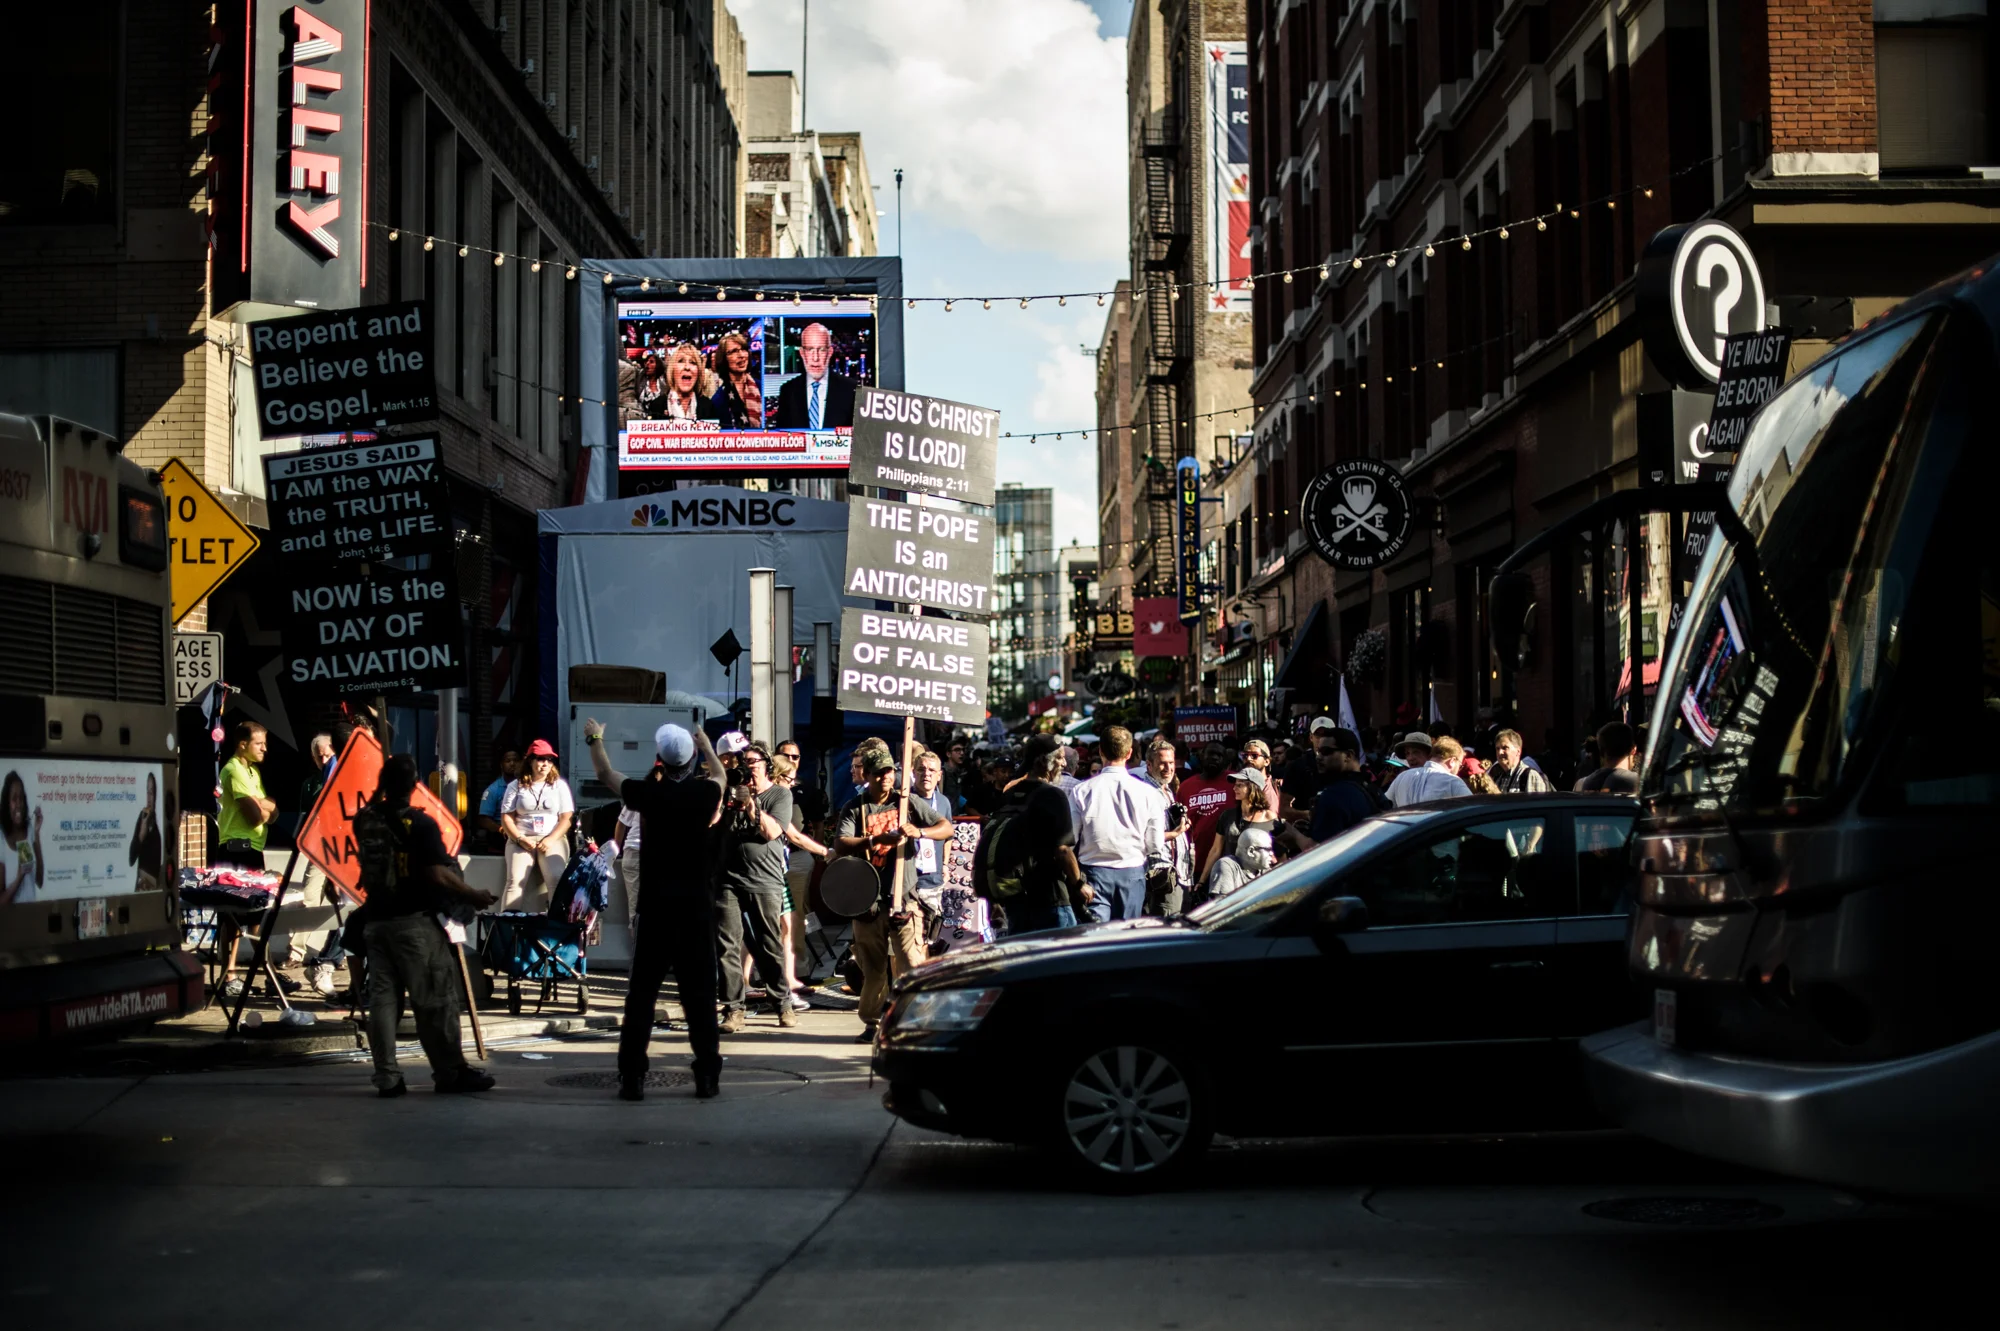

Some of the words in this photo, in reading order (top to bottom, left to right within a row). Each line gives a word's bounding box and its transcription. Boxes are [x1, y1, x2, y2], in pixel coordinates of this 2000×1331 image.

[290, 5, 342, 258] ALLEY
[254, 316, 358, 353] Repent
[367, 307, 421, 338] and
[1727, 341, 1743, 369] YE
[1743, 335, 1785, 366] MUST
[261, 358, 368, 389] Believe
[376, 348, 423, 374] the
[265, 389, 378, 425] Gospel.
[383, 399, 407, 412] Mark
[409, 397, 430, 408] 1.15
[1717, 382, 1735, 408] BE
[1736, 376, 1779, 405] BORN
[641, 423, 687, 431] BREAKING
[690, 423, 718, 431] NEWS
[860, 392, 922, 424] JESUS
[927, 401, 994, 438] CHRIST
[630, 437, 645, 449] GOP
[646, 437, 663, 449] CIVIL
[664, 438, 680, 448] WAR
[681, 437, 708, 448] BREAKS
[709, 437, 723, 448] OUT
[724, 437, 735, 448] ON
[735, 436, 780, 448] CONVENTION
[781, 436, 804, 447] FLOOR
[1707, 417, 1750, 446] AGAIN
[284, 453, 359, 476] JESUS
[366, 444, 420, 464] SAID
[884, 432, 903, 459] IS
[908, 436, 967, 469] LORD!
[271, 484, 278, 501] I
[285, 478, 324, 500] AM
[332, 475, 370, 493] the
[377, 463, 439, 486] WAY,
[877, 466, 943, 487] Philippians
[946, 479, 969, 492] 2:11
[1316, 473, 1333, 491] CLE
[1336, 462, 1386, 476] CLOTHING
[1388, 475, 1402, 491] CO.
[1682, 461, 1700, 478] VIS
[63, 466, 108, 534] RTA
[287, 507, 327, 525] the
[333, 491, 429, 519] TRUTH,
[672, 499, 795, 527] MSNBC
[1183, 467, 1197, 531] HOUSE
[280, 530, 326, 552] and
[333, 527, 372, 546] the
[381, 515, 443, 539] LIFE.
[867, 503, 912, 532] THE
[918, 511, 979, 543] POPE
[338, 549, 365, 559] John
[368, 544, 391, 555] 14:6
[895, 540, 916, 565] IS
[922, 549, 947, 571] an
[1318, 538, 1342, 560] WEAR
[1348, 556, 1373, 566] YOUR
[1378, 536, 1404, 560] PRIDE
[1685, 533, 1709, 556] FRO
[292, 583, 361, 613] NOW
[370, 582, 394, 604] is
[402, 578, 445, 601] the
[850, 567, 987, 609] ANTICHRIST
[319, 616, 376, 645] DAY
[385, 612, 424, 638] OF
[862, 614, 968, 647] BEWARE
[1140, 621, 1182, 635] 216
[175, 640, 211, 657] AGE
[291, 644, 459, 682] SALVATION.
[853, 642, 890, 665] OF
[897, 647, 974, 676] FALSE
[176, 661, 211, 678] ESS
[347, 679, 399, 692] Corinthians
[401, 677, 415, 686] 6:2
[177, 682, 198, 698] LY
[843, 670, 981, 706] PROPHETS.
[875, 699, 924, 713] Matthew
[926, 704, 950, 716] 7:15
[1177, 723, 1215, 734] AMERICA
[1217, 723, 1234, 731] CAN
[1184, 734, 1197, 742] DO
[37, 773, 60, 784] Women
[61, 775, 68, 786] go
[69, 774, 75, 784] to
[76, 773, 84, 784] the
[86, 773, 102, 784] doctor
[103, 775, 115, 784] more
[116, 774, 126, 784] than
[127, 776, 136, 784] men
[54, 791, 67, 803] they
[68, 791, 78, 801] live
[88, 820, 107, 830] CHANGE
[66, 991, 167, 1029] www.rideRTA.com
